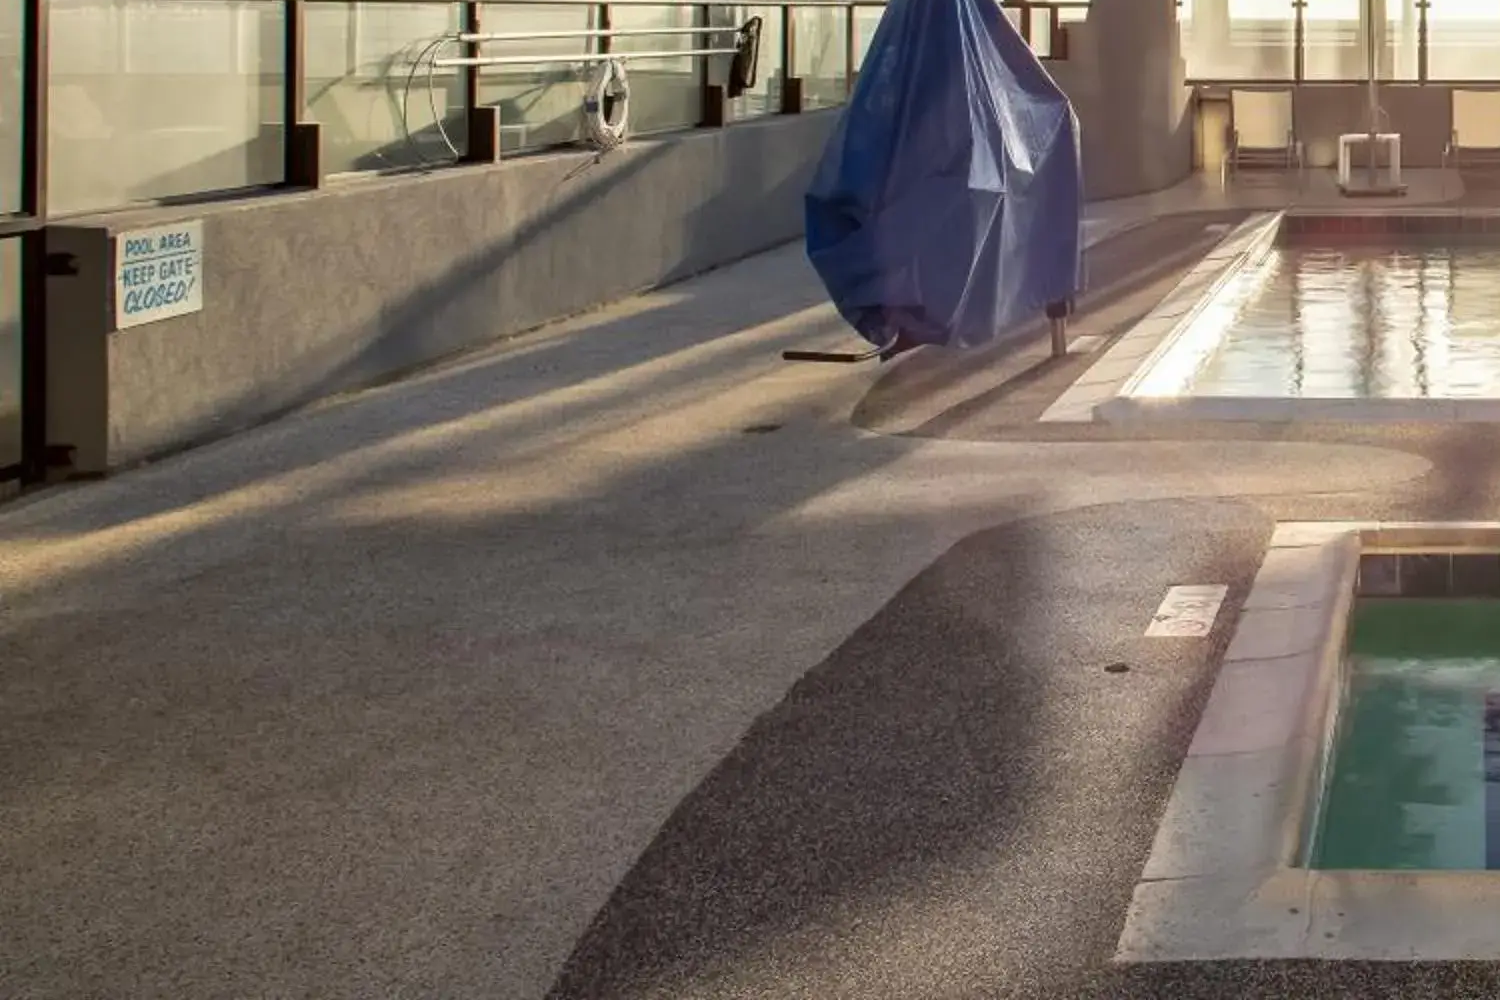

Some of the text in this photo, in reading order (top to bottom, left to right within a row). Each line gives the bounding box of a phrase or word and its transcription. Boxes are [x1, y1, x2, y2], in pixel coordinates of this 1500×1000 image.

[125, 232, 191, 258] POOL AREA
[123, 257, 192, 287] KEEP GATE
[123, 277, 195, 313] CLOSED!
